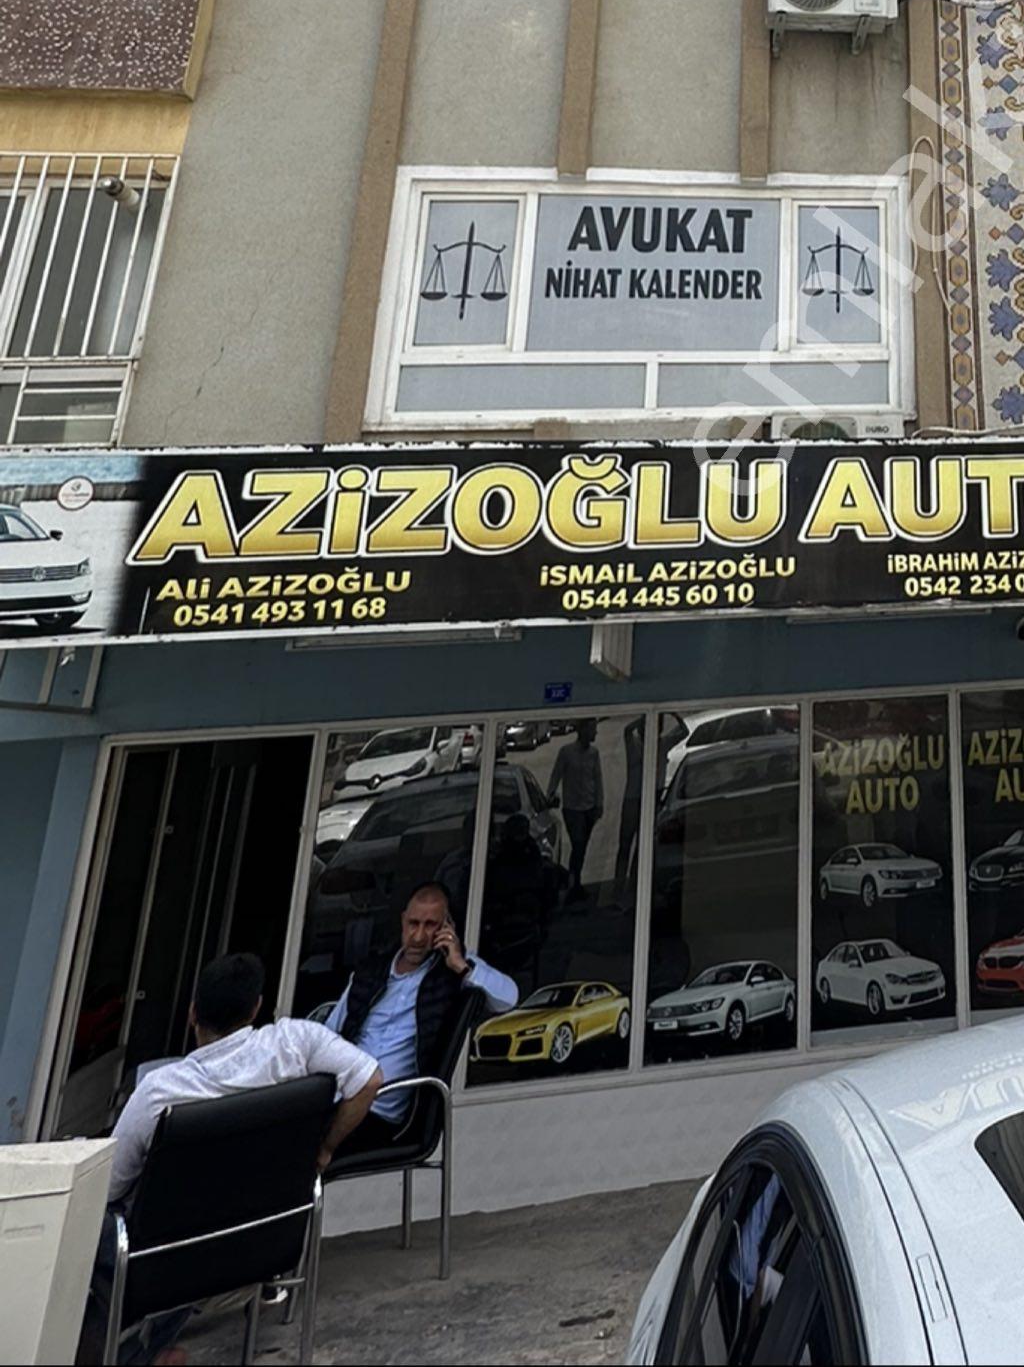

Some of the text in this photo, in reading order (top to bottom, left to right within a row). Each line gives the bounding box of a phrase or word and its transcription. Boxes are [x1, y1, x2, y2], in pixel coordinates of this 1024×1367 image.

[567, 205, 753, 254] AVUKAT
[545, 260, 762, 300] NİHAT KALENDER
[562, 583, 754, 610] 0544 445 60 10
[904, 576, 962, 597] 0542
[969, 574, 1012, 595] 234
[173, 597, 386, 627] 0541 493 11 68
[845, 777, 920, 815] AUTO
